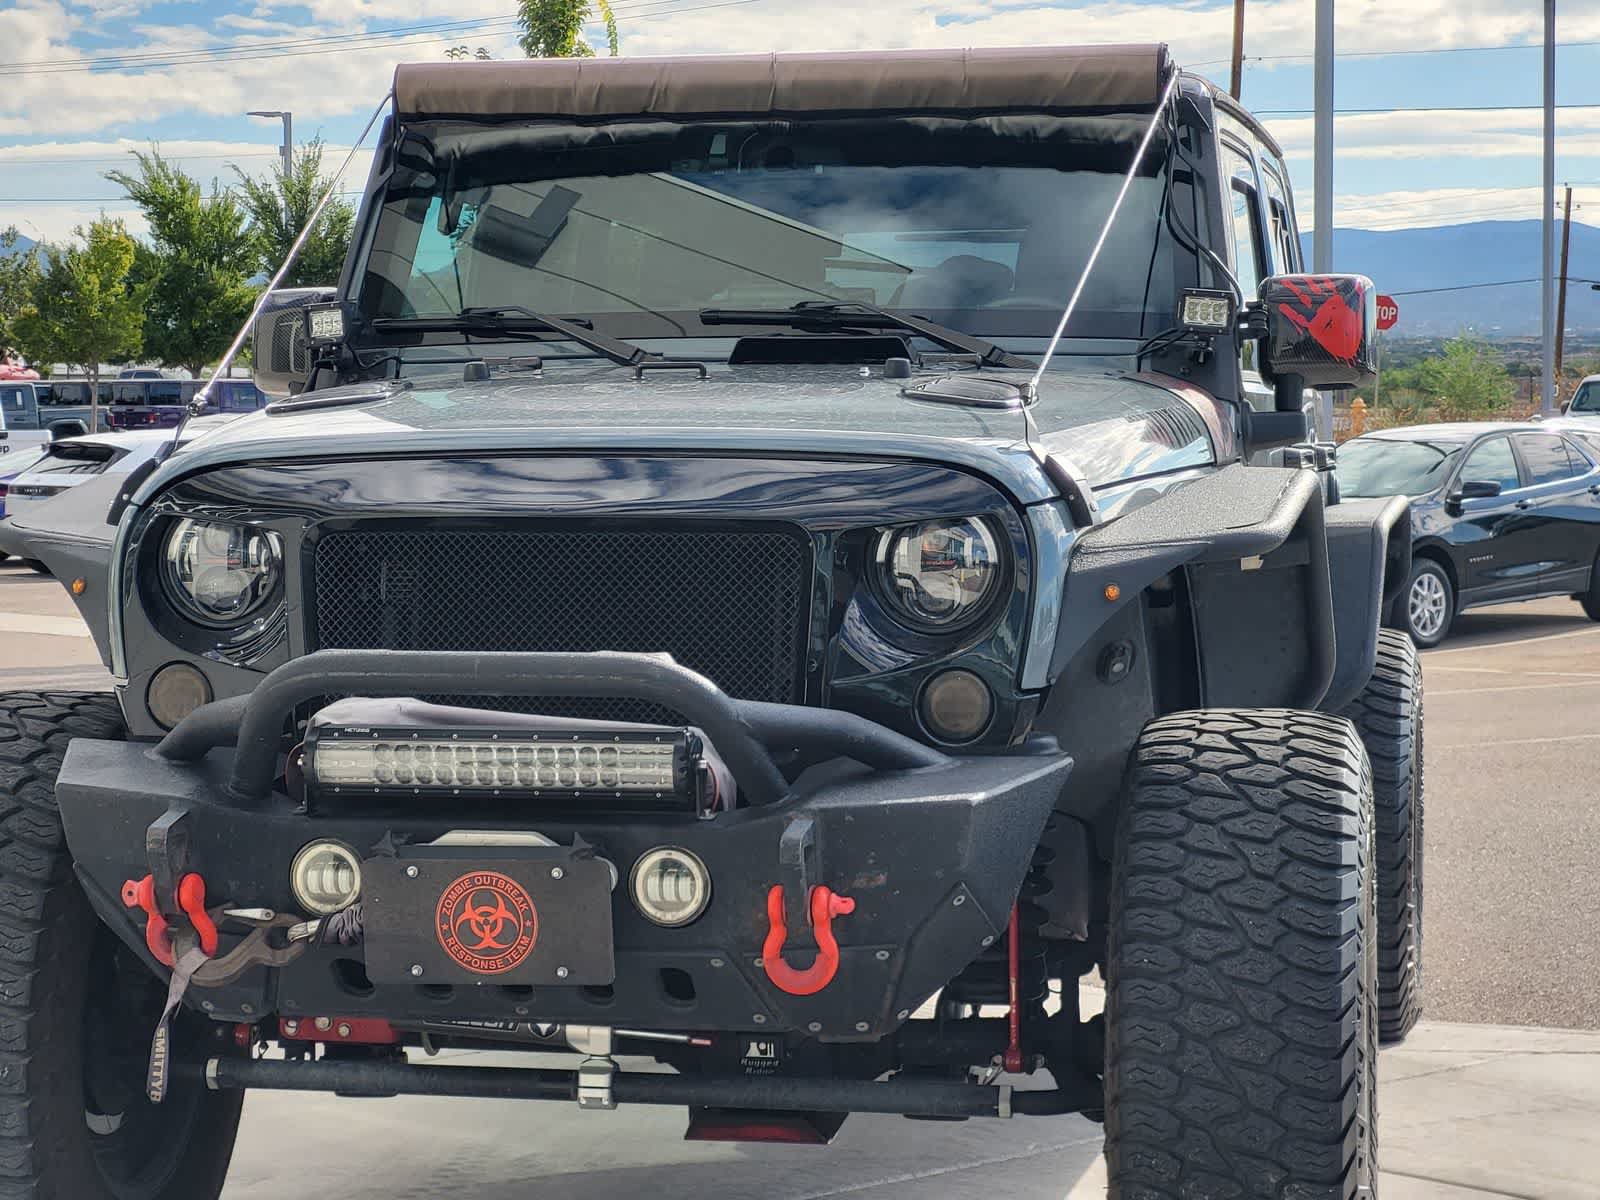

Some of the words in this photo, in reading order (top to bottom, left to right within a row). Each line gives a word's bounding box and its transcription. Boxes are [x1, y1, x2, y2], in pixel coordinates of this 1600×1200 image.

[1376, 305, 1396, 321] TOP
[441, 879, 473, 915] ZOMBIE
[474, 876, 529, 913] OUTBREAK
[446, 936, 505, 970] RESPONSE
[505, 935, 530, 963] TEAM
